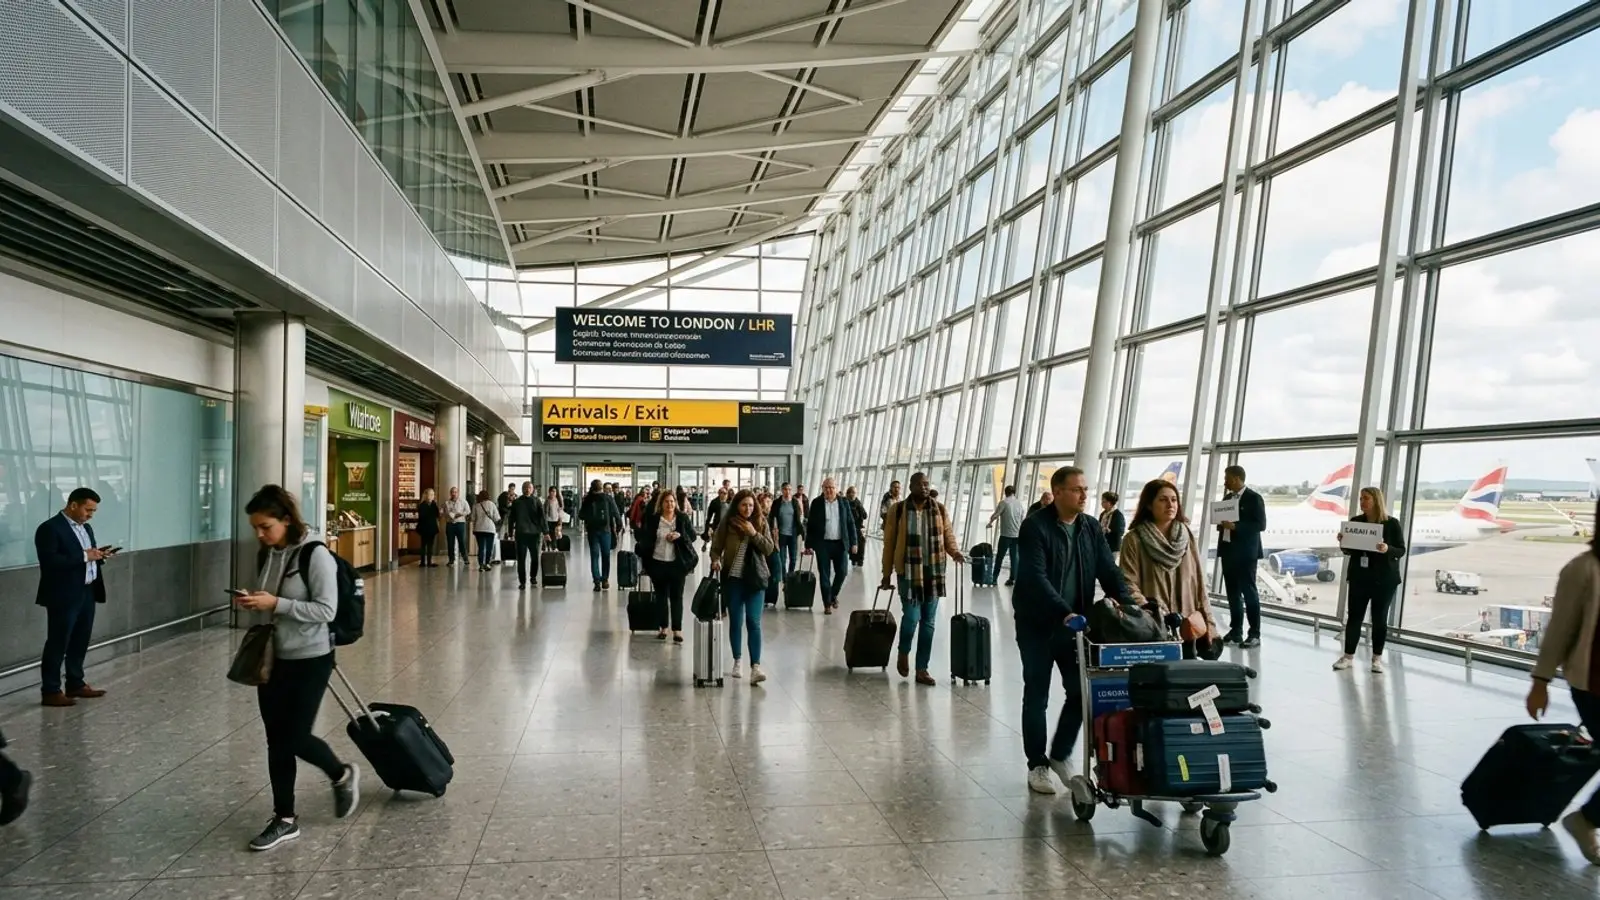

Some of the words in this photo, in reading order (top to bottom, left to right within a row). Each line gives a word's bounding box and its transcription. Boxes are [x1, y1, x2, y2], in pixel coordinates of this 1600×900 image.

[573, 314, 646, 328] WELCOME
[650, 316, 670, 329] TO
[674, 317, 735, 330] LONDON
[748, 319, 775, 331] LHR
[547, 404, 618, 420] Arrivals
[623, 405, 630, 420] /
[635, 405, 669, 420] Exit
